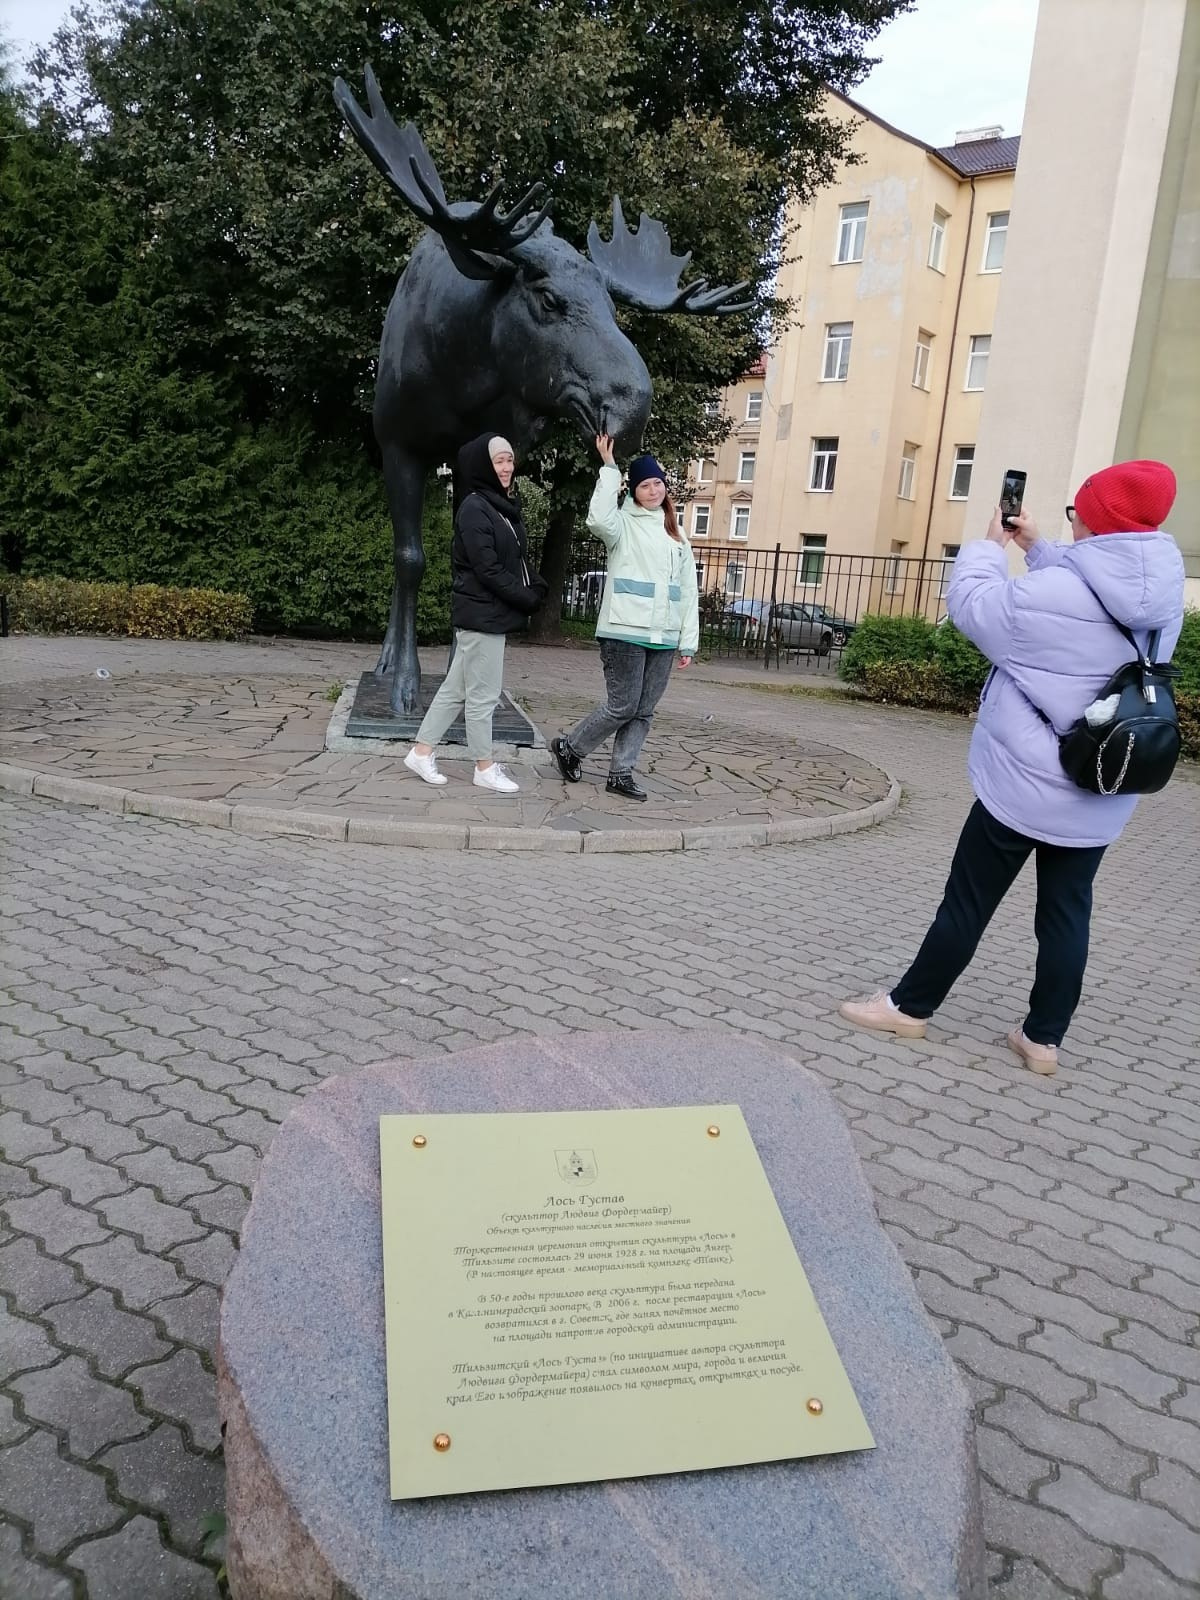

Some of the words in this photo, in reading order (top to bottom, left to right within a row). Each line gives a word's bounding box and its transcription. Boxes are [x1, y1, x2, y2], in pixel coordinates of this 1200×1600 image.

[544, 1196, 576, 1208] Лось
[578, 1194, 624, 1208] Густав
[502, 1212, 558, 1224] (скульптор
[518, 1254, 571, 1264] состоялась
[574, 1252, 584, 1261] 29
[616, 1248, 637, 1258] 1928
[662, 1245, 700, 1256] площади
[538, 1240, 587, 1252] церемония
[536, 1266, 565, 1278] время
[512, 1291, 536, 1302] годы
[586, 1288, 607, 1298] века
[610, 1284, 666, 1299] скульптура
[668, 1281, 692, 1292] была
[694, 1278, 736, 1290] передана
[608, 1298, 630, 1308] 2006
[645, 1297, 670, 1306] после
[674, 1292, 734, 1306] реставрации
[616, 1310, 630, 1321] где
[710, 1304, 740, 1313] место
[494, 1335, 506, 1343] на
[508, 1330, 552, 1342] площади
[606, 1324, 654, 1336] городской
[452, 1360, 530, 1374] Тильзитский
[610, 1352, 626, 1364] (по
[628, 1347, 689, 1361] инициативе
[728, 1338, 786, 1354] скульптора
[457, 1376, 505, 1390] Людвига
[620, 1364, 669, 1376] символом
[672, 1361, 700, 1373] мира,
[704, 1356, 736, 1369] города
[748, 1352, 786, 1363] величия
[570, 1382, 622, 1395] появилось
[624, 1381, 637, 1390] на
[640, 1376, 696, 1390] конвертах,
[698, 1368, 760, 1384] открытках
[762, 1368, 768, 1376] и
